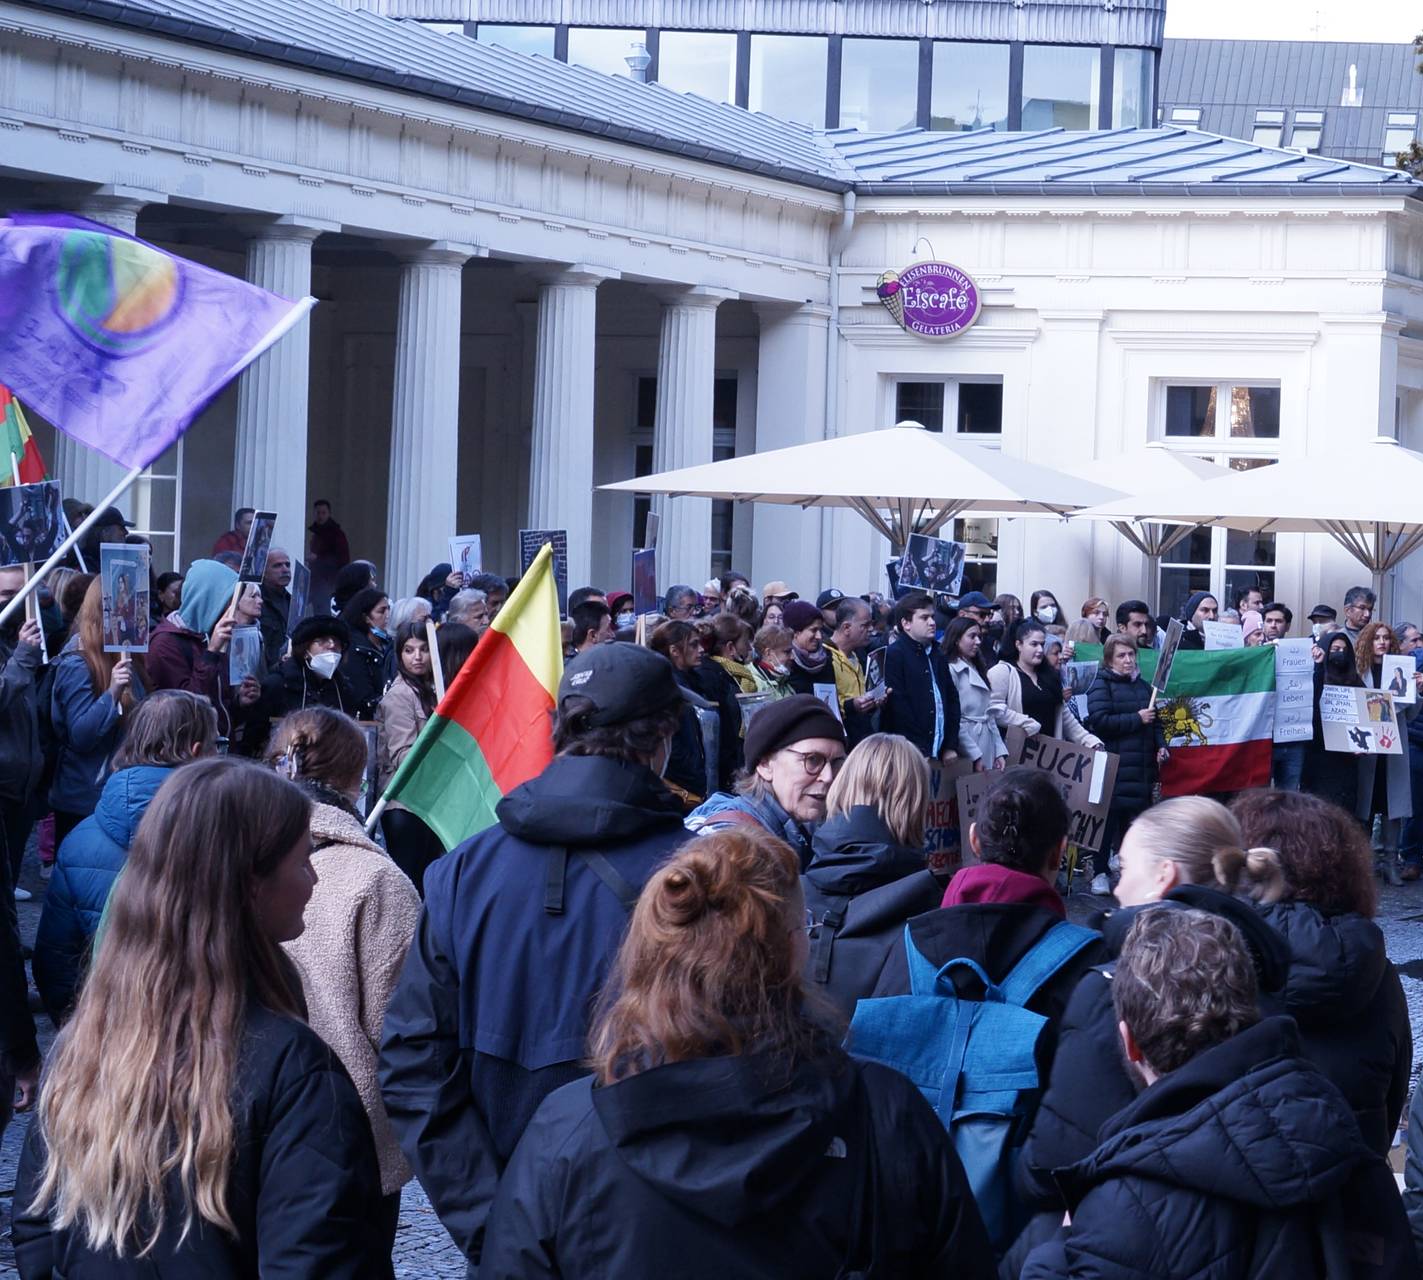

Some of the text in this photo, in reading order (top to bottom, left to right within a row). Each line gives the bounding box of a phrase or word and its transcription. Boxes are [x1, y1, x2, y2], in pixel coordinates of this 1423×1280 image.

[900, 265, 971, 290] ELISENBRUNNEN
[902, 287, 968, 310] Eiscafé
[911, 321, 961, 334] GELATERIA
[1282, 658, 1307, 666] Frauen
[1282, 694, 1304, 703] Leben
[1279, 727, 1306, 735] Freiheit
[1018, 737, 1091, 783] FUCK
